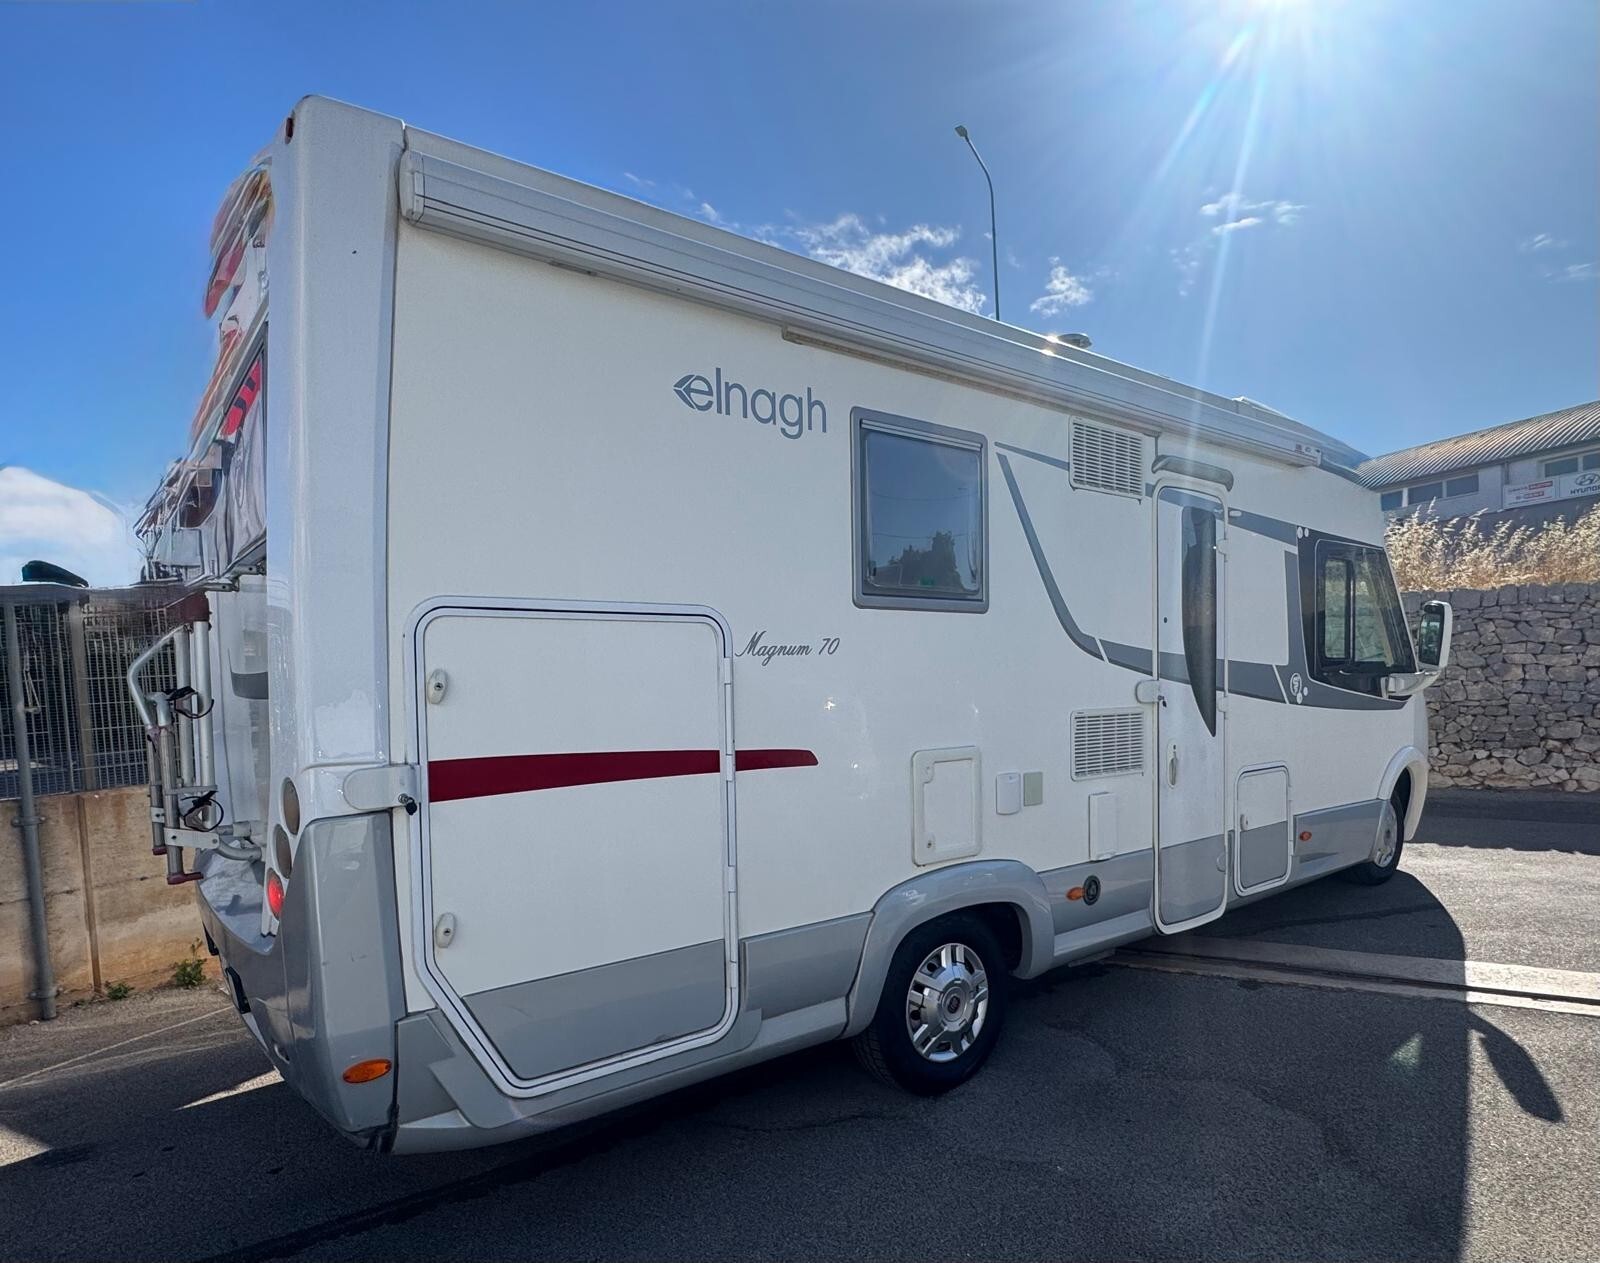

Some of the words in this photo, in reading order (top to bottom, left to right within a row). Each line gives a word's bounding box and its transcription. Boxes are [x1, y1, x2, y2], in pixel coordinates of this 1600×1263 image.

[674, 367, 827, 439] elnagh
[734, 630, 813, 667] Magnum
[818, 637, 841, 655] 70
